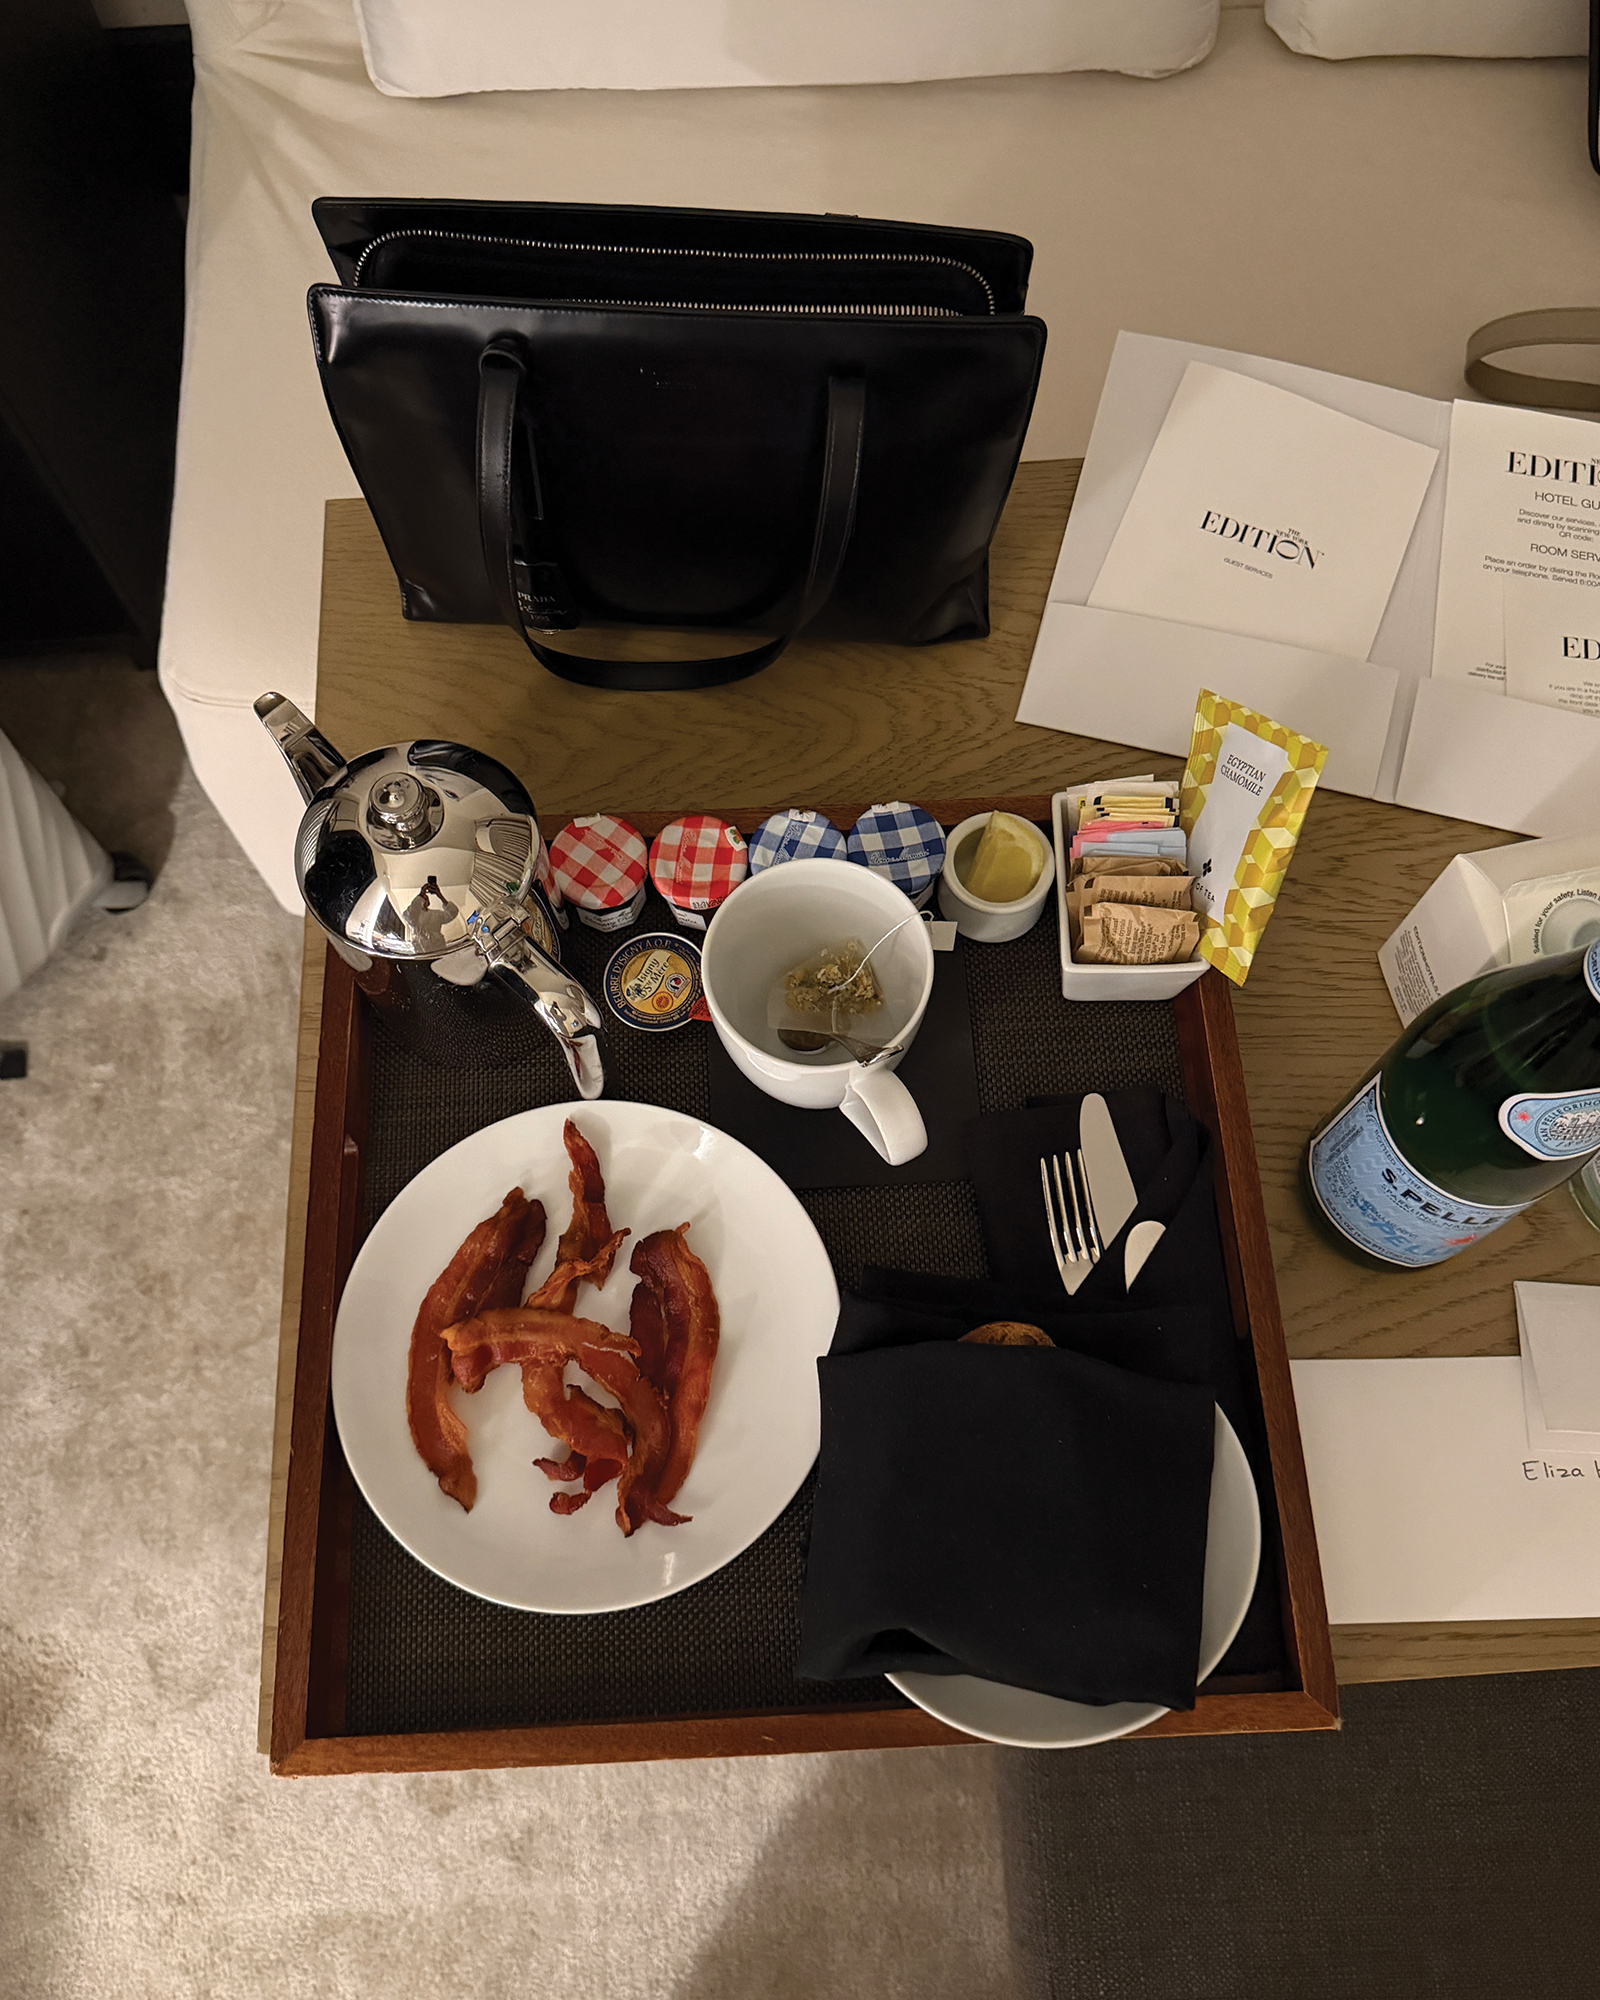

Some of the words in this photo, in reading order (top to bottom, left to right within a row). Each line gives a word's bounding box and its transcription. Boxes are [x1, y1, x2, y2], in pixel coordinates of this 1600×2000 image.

[1505, 450, 1600, 487] EDITI
[1534, 491, 1578, 507] HOTEL
[1518, 508, 1550, 519] Discover
[1275, 529, 1291, 539] NEW
[1533, 518, 1555, 529] dining
[1556, 523, 1566, 531] by
[1567, 524, 1600, 536] scanning
[1559, 531, 1572, 539] QR
[1199, 509, 1323, 569] EDITION
[1530, 543, 1568, 557] ROOM
[1223, 557, 1244, 568] GUEST
[1244, 562, 1274, 579] SERVICES
[1484, 555, 1505, 564] Place
[1539, 565, 1548, 573] by
[1589, 572, 1600, 580] Ro
[1552, 574, 1578, 584] Served
[1227, 754, 1266, 782] EGYPTIAN
[1220, 764, 1264, 797] CHAMOMILE
[1195, 882, 1204, 892] OF
[1204, 889, 1216, 903] TEA
[1535, 917, 1543, 927] for
[1541, 901, 1553, 918] your
[637, 958, 660, 983] Isigny
[610, 974, 627, 1009] BEURRE
[1540, 1128, 1552, 1142] SAN
[1374, 1129, 1396, 1166] BOTTLED
[1396, 1167, 1407, 1177] AT
[1407, 1177, 1424, 1191] THE
[1425, 1190, 1462, 1212] SOURCE
[1522, 1460, 1584, 1481] Eliza
